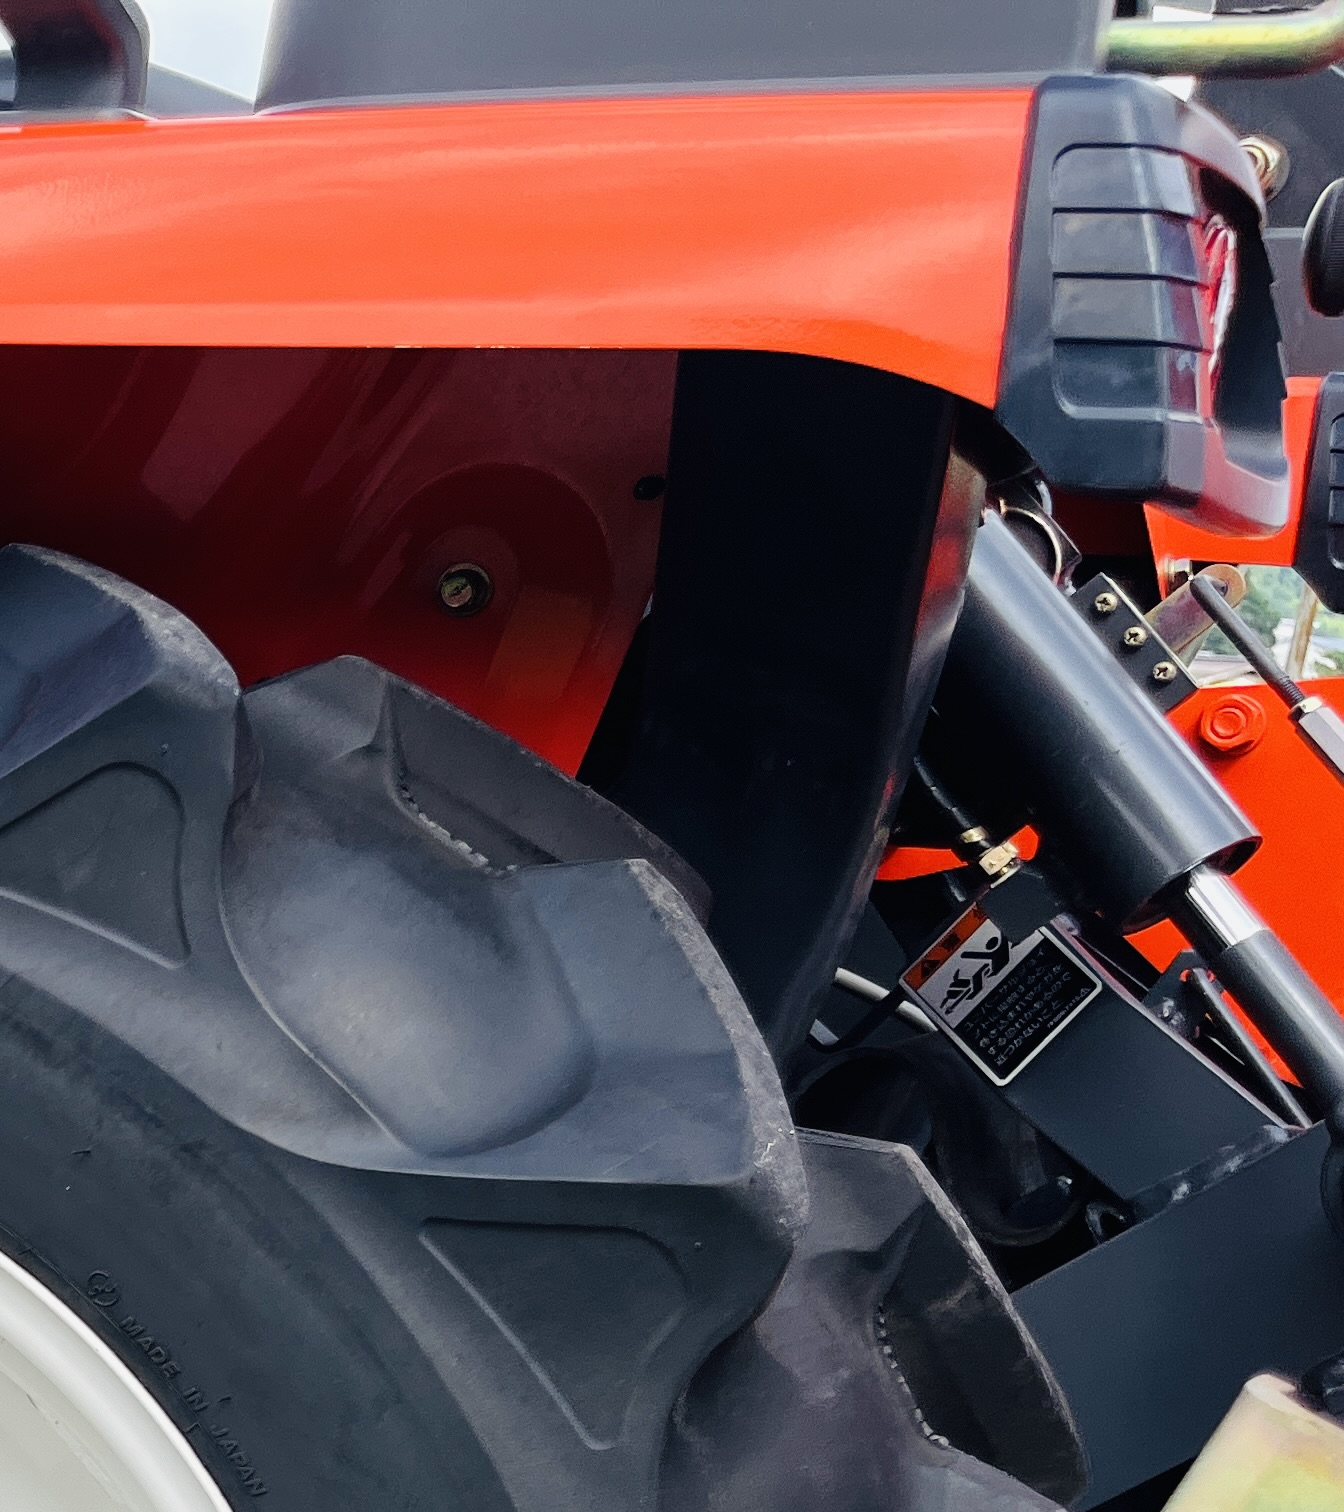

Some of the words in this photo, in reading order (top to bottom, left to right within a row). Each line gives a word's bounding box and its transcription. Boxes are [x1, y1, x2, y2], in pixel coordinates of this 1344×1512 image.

[119, 1315, 181, 1378] MADE
[183, 1385, 210, 1412] IN
[212, 1424, 270, 1498] JAPAN
